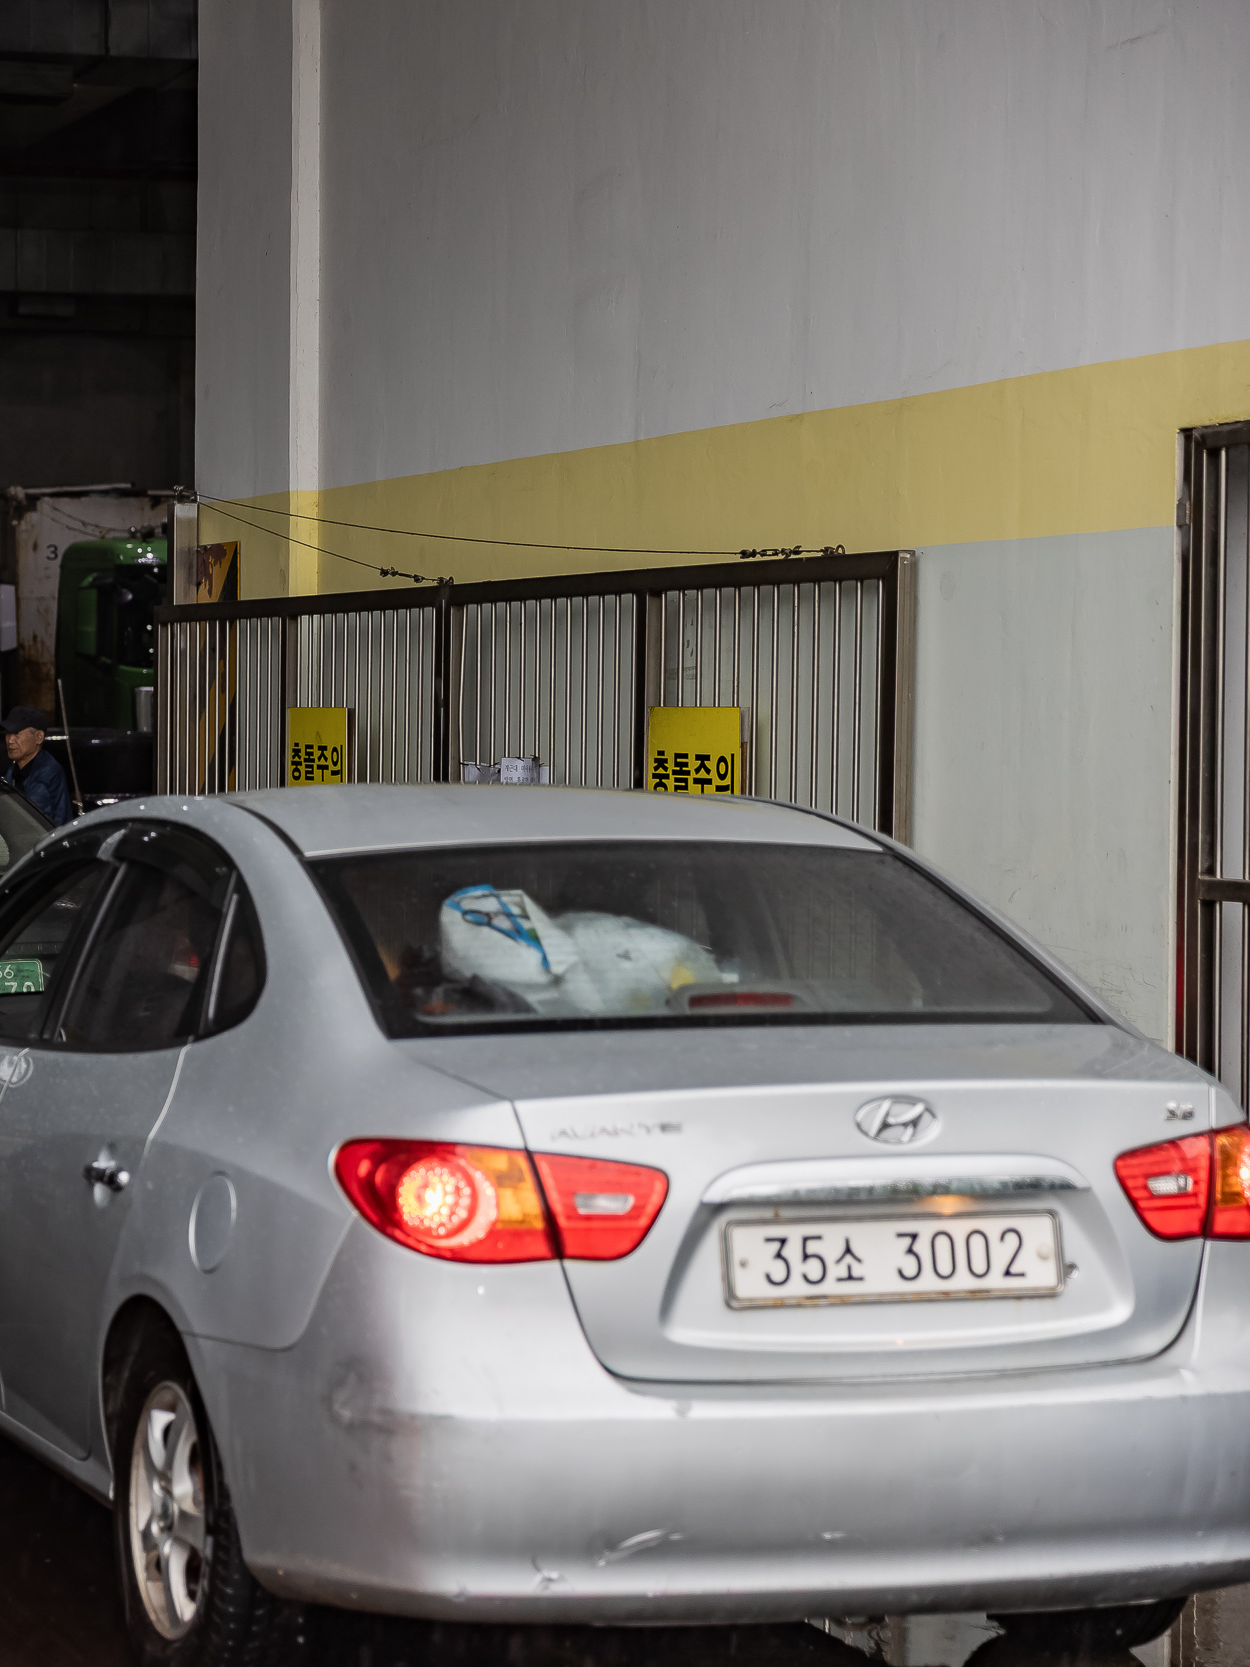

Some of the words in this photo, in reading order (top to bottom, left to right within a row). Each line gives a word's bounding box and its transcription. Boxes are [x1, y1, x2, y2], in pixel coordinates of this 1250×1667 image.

[46, 544, 59, 561] 3
[291, 742, 344, 783] 충돌주의
[652, 750, 735, 795] 충돌주의
[763, 1234, 865, 1287] 35소
[895, 1227, 1027, 1282] 3002
